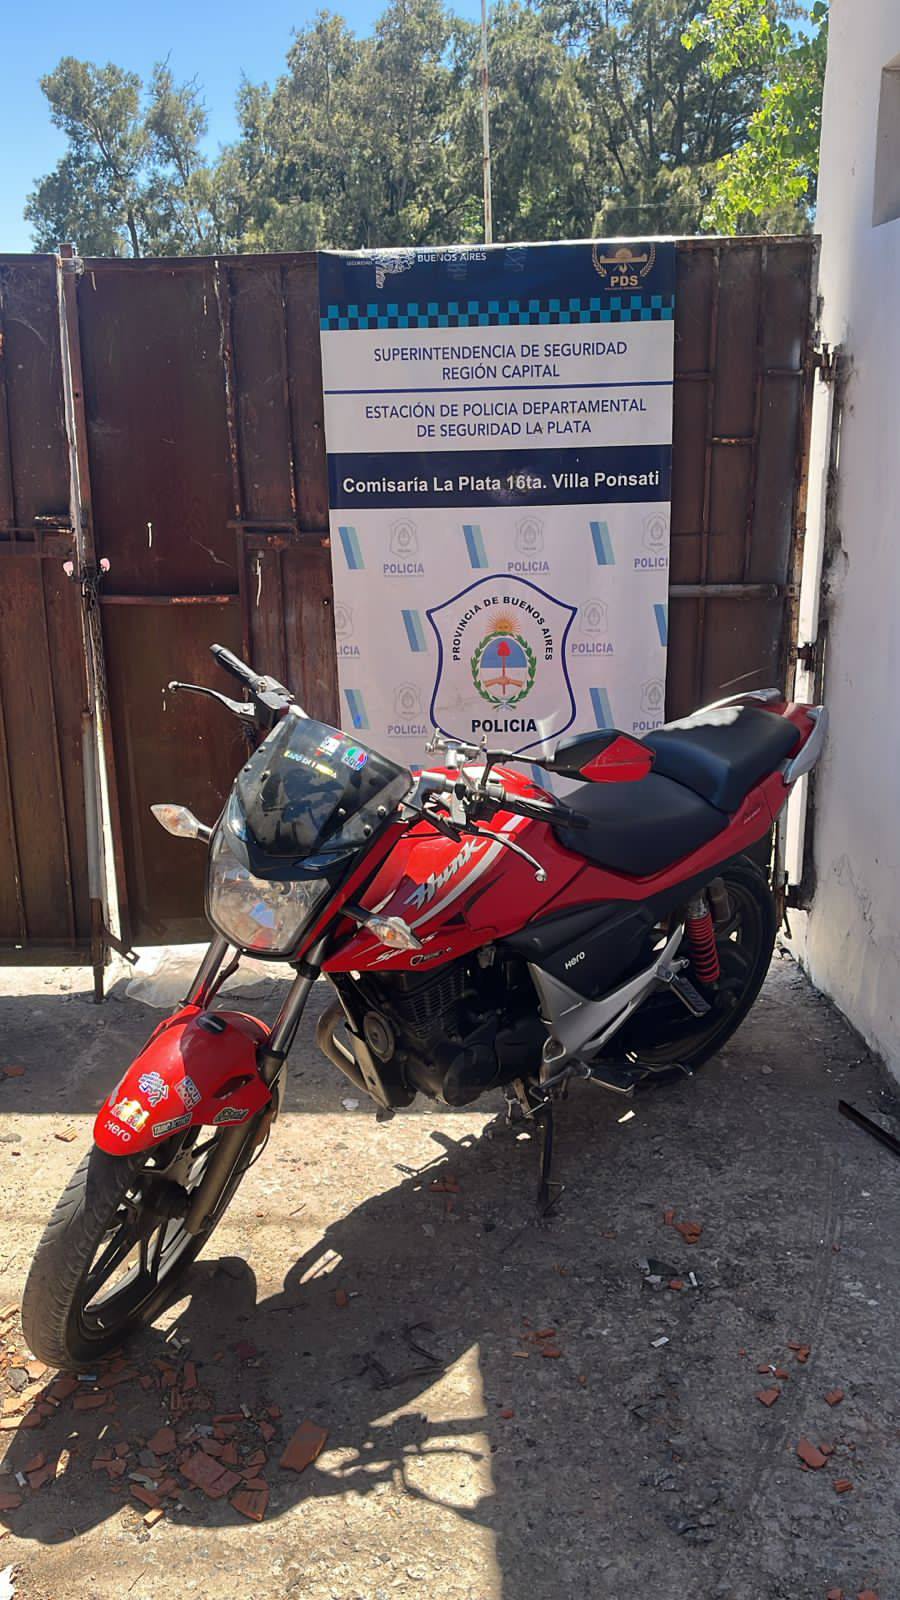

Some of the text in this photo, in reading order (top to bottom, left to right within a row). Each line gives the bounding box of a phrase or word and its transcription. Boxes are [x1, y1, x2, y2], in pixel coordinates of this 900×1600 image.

[417, 252, 487, 262] BUENOS AIRES
[610, 275, 639, 287] PDS
[374, 342, 627, 362] SUPERINTENDENCIA DE SEGURIDAD
[442, 363, 560, 380] REGIÓN CAPITAL
[365, 398, 647, 419] ESTACIÓN DE POLICIA DEPARTAMENTAL
[417, 421, 591, 437] DE SEGURIDAD LA PLATA
[343, 471, 659, 492] Comisaría La Plata 16ta. Villa Ponsati
[383, 563, 424, 574] POLICIA
[508, 561, 549, 572] POLICIA
[452, 596, 553, 661] PROVINCIA DE BUENOS AIRES
[571, 643, 614, 653] POLICIA
[387, 724, 428, 735] POLICIA
[471, 719, 537, 733] POLICIA
[564, 951, 586, 970] Hero
[104, 1120, 131, 1143] Hero
